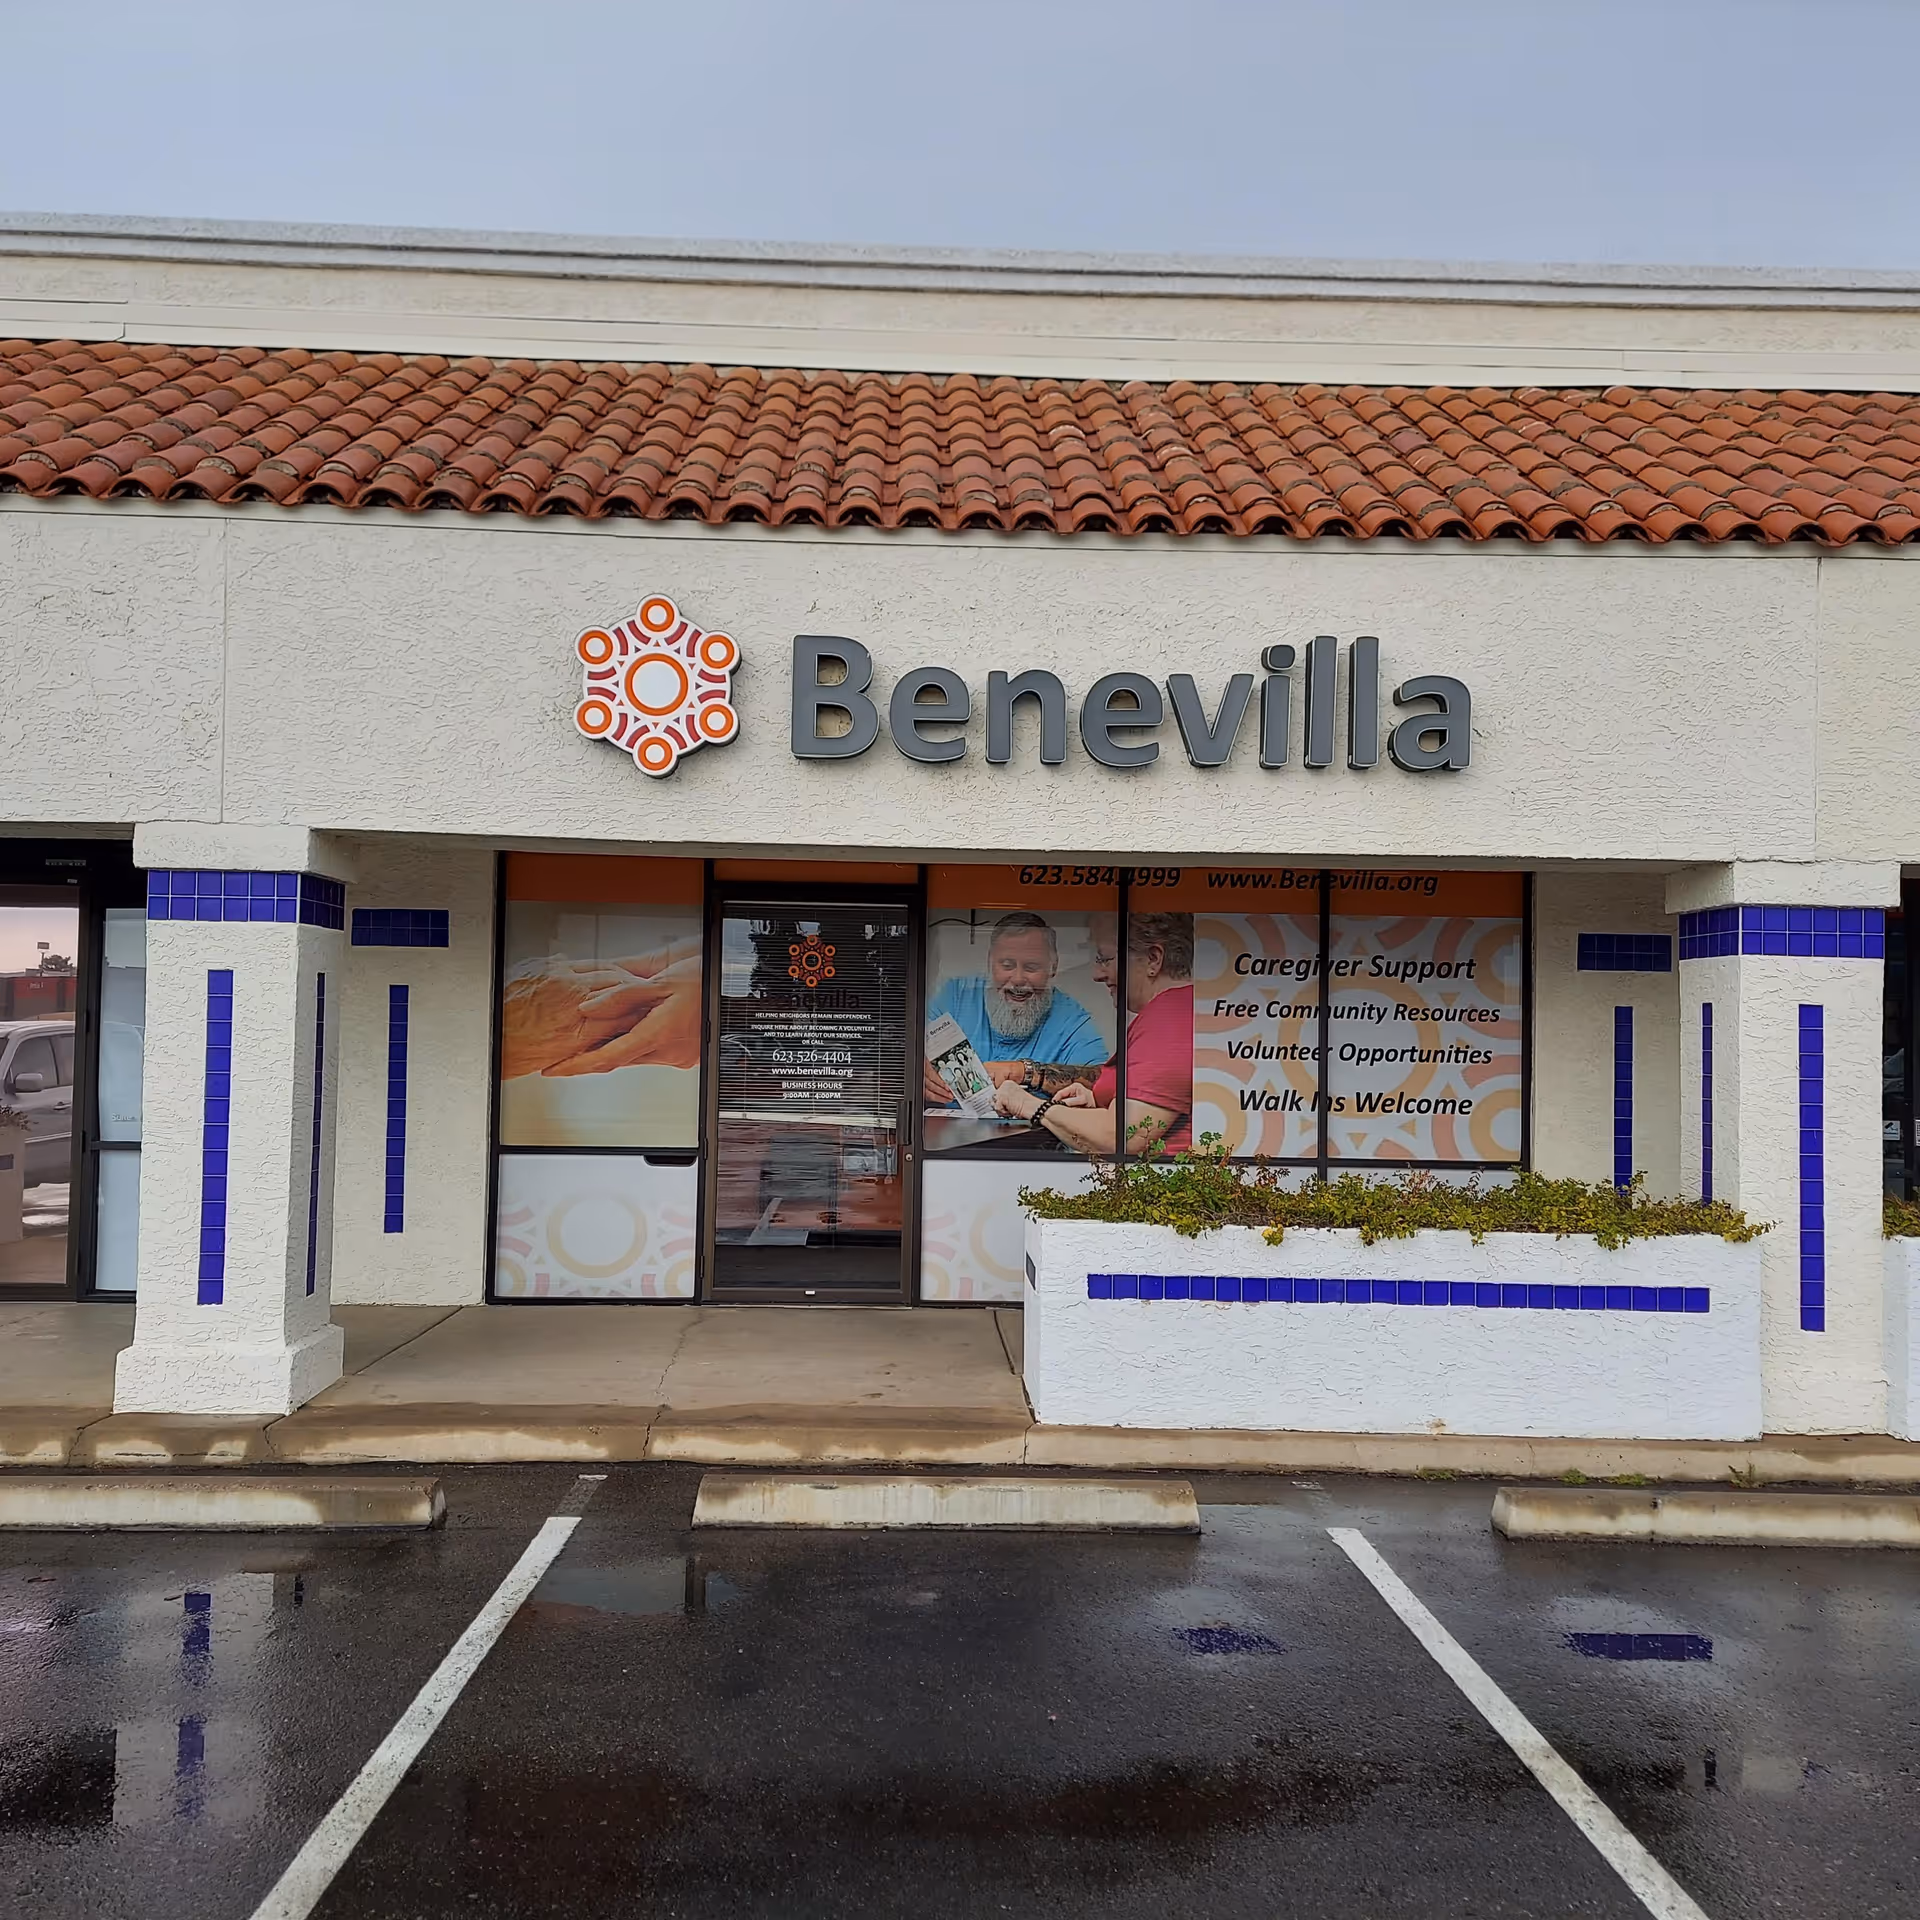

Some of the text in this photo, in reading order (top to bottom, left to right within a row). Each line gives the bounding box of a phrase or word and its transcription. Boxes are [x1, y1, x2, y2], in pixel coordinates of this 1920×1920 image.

[789, 633, 1472, 772] Benevilla
[1368, 954, 1477, 983] Support
[1213, 1000, 1260, 1018] Free
[1393, 1003, 1501, 1023] Resources
[1338, 1043, 1493, 1067] Opportunities
[771, 1066, 854, 1078] www.benevilla.org
[1239, 1089, 1304, 1112] Walk
[1355, 1091, 1473, 1115] Welcome
